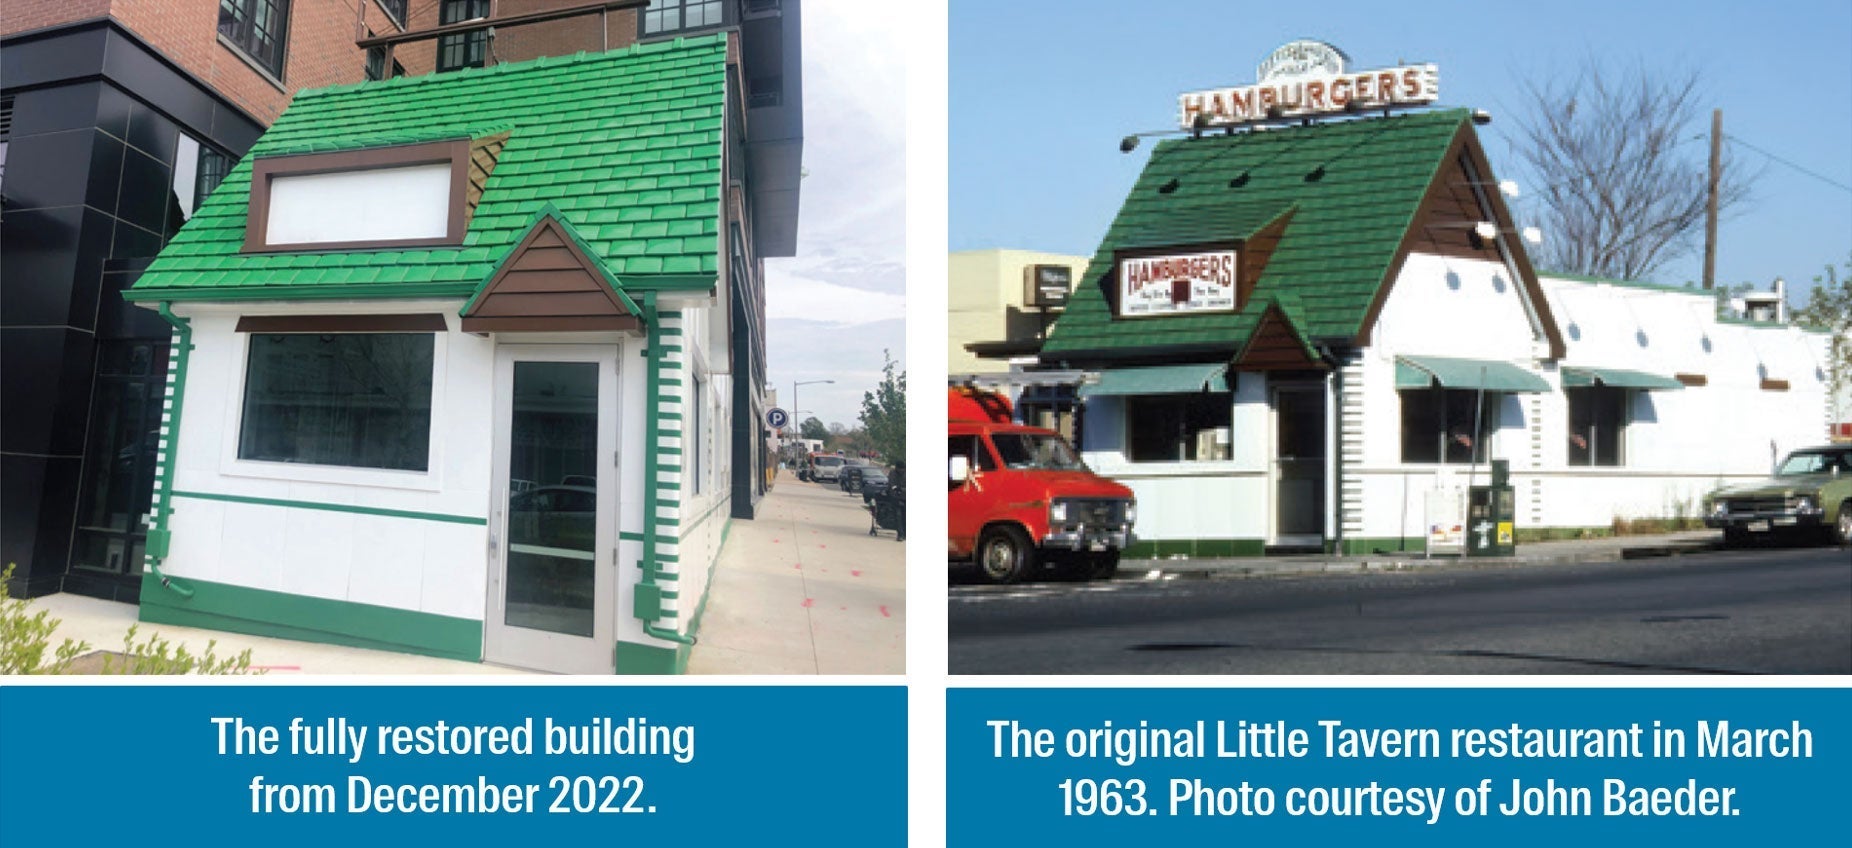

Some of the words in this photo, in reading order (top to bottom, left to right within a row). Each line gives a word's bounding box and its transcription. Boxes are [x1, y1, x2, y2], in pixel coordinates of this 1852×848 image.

[1184, 69, 1422, 125] HAMBURGERS
[1127, 255, 1232, 296] HAMBURGERS
[773, 413, 783, 425] P
